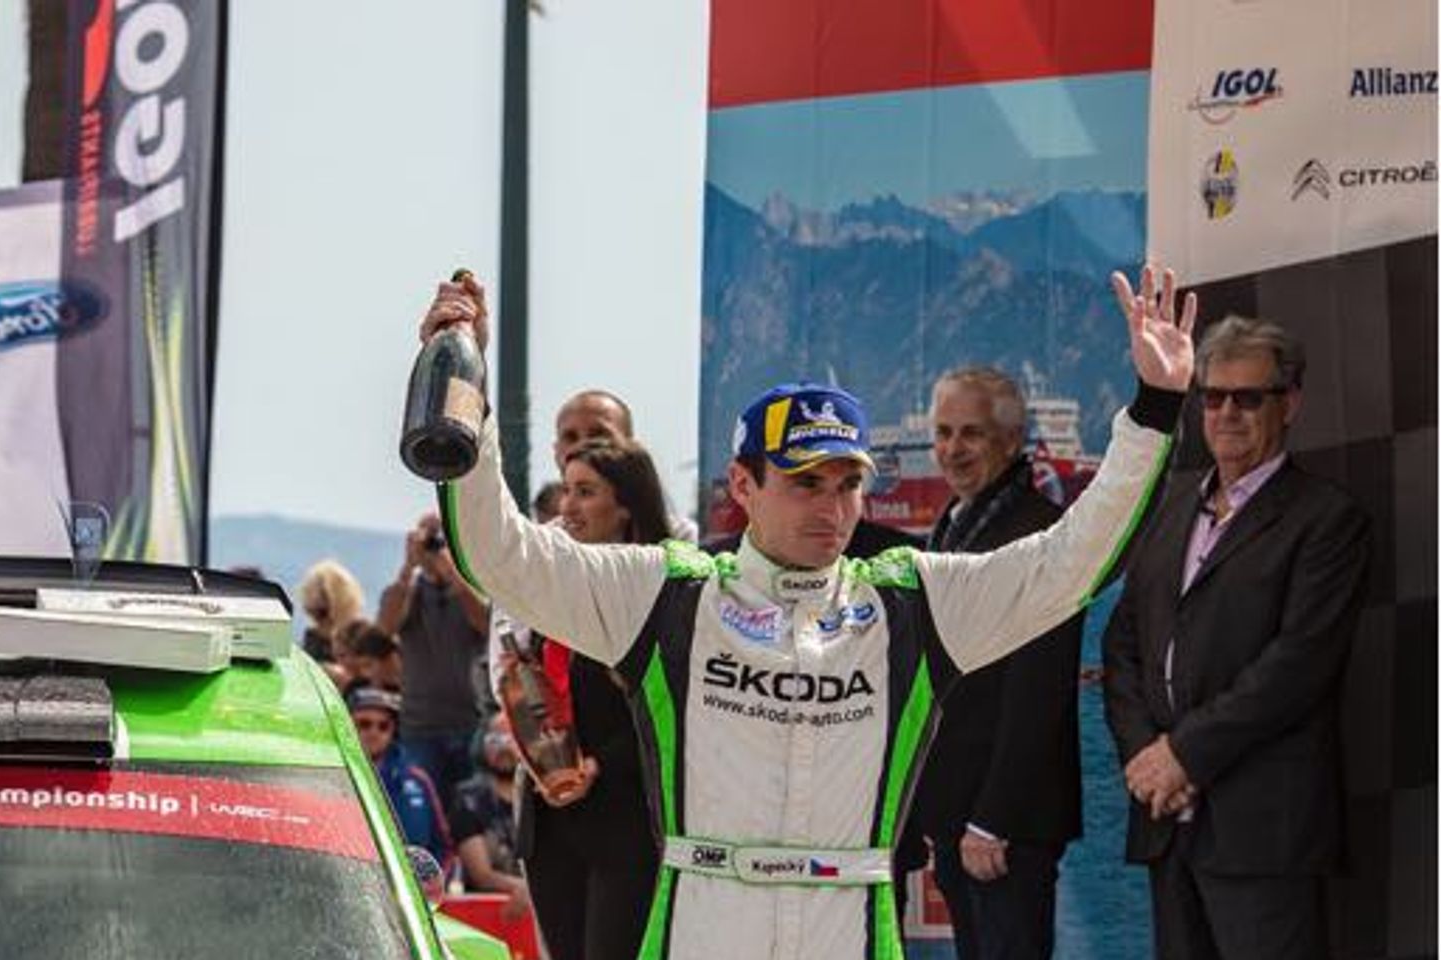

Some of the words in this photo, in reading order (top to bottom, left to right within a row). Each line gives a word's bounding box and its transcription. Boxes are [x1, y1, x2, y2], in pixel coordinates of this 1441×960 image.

[1211, 68, 1278, 98] IGOL
[1349, 66, 1438, 97] Allianz
[1338, 160, 1438, 187] CITROË
[703, 653, 875, 703] ŠKODA
